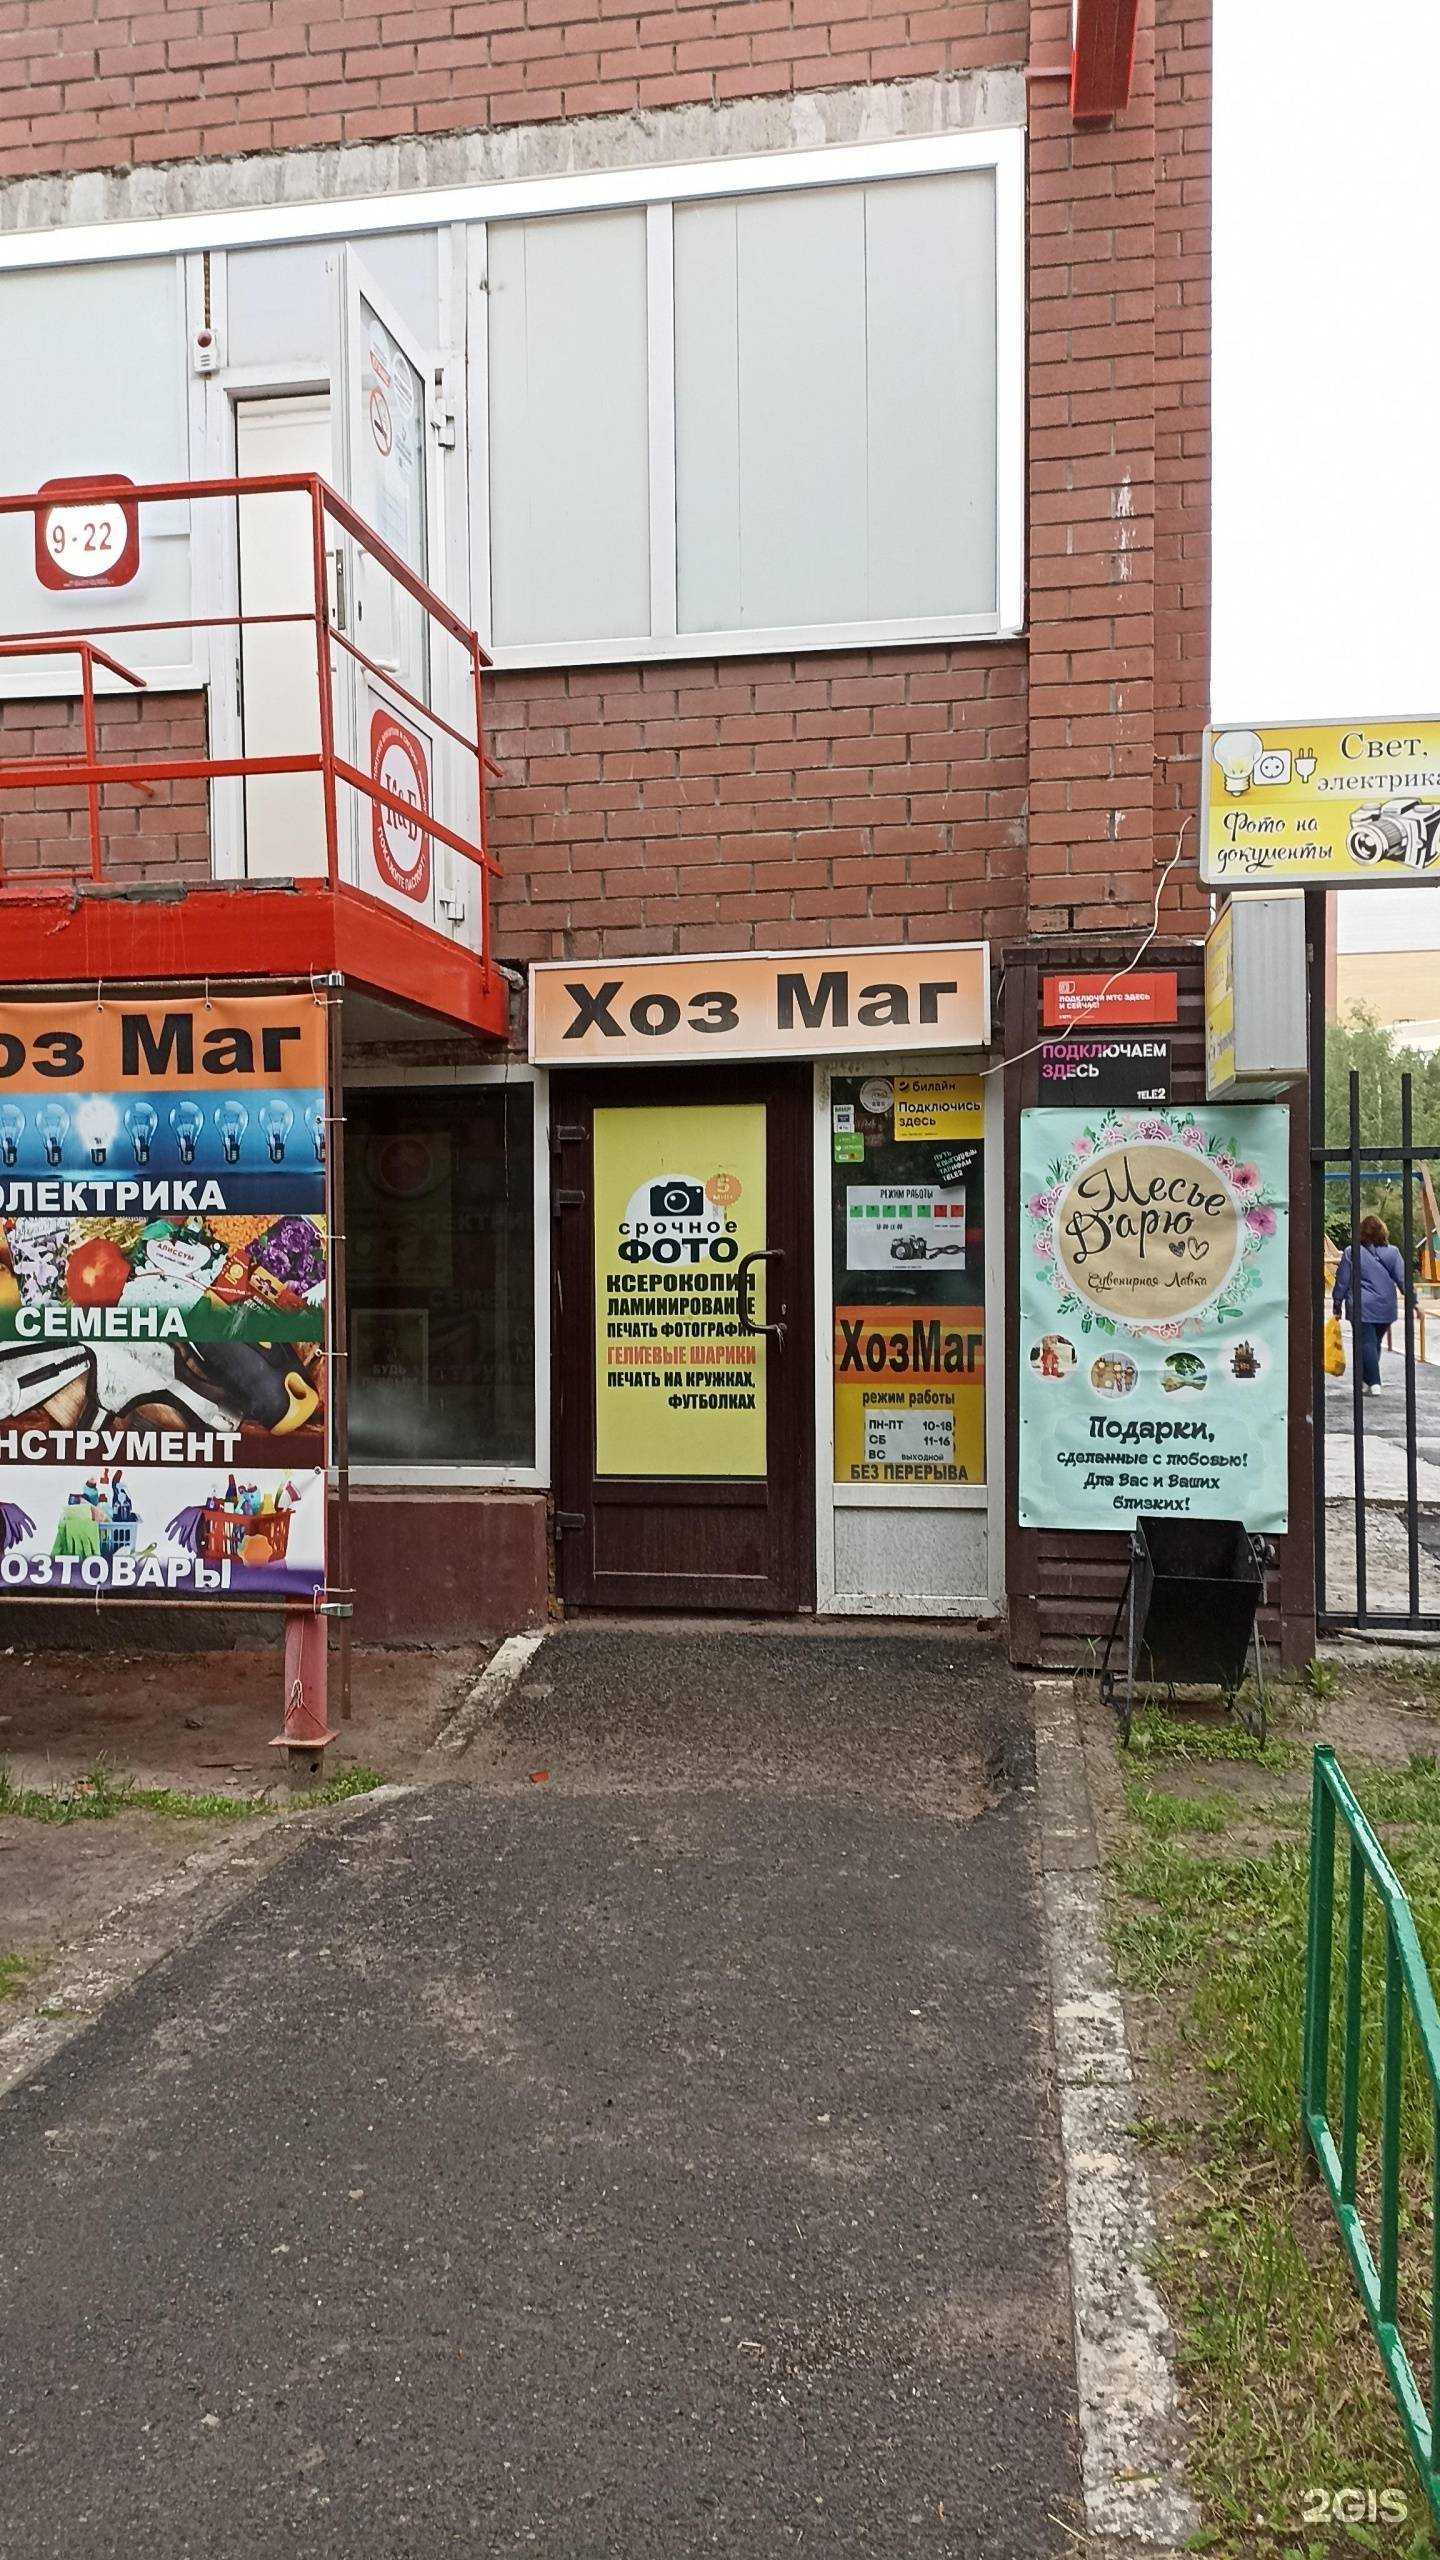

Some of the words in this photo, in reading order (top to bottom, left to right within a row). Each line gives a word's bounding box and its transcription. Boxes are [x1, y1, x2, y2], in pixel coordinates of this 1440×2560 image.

[1341, 732, 1428, 759] Свет,
[1223, 811, 1286, 842] Фото
[1296, 818, 1318, 832] на
[1217, 843, 1333, 874] документы
[562, 980, 740, 1040] Хоз
[777, 970, 958, 1030] Маг
[121, 1013, 302, 1077] Маг
[1042, 1043, 1167, 1061] ПОДКЛЮЧАЕМ
[1042, 1063, 1100, 1080] ЗДЕСЬ
[912, 1081, 956, 1093] билайн
[1137, 1088, 1166, 1100] TELE2
[899, 1101, 981, 1114] Подключись
[899, 1115, 936, 1128] здесь
[0, 1181, 227, 1212] ЛЕКТРИКА
[618, 1221, 738, 1238] срочное
[617, 1237, 739, 1264] ФОТО
[1088, 1271, 1159, 1293] Сувенирная
[1165, 1271, 1207, 1288] Лавка
[607, 1297, 756, 1316] ЛАМИНИРОВАНЕ
[14, 1305, 188, 1339] СЕМЕНА
[607, 1322, 658, 1338] ПЕЧАТЬ
[607, 1346, 687, 1365] ГЕЛИЕВЫЕ
[690, 1345, 756, 1365] ШАРИКИ
[839, 1319, 982, 1374] ХозМаг
[607, 1371, 661, 1388] ПЕЧАТЬ
[664, 1371, 683, 1388] НА
[686, 1371, 756, 1388] КРУЖКАХ,
[668, 1394, 756, 1410] ФУТБОЛКАХ
[862, 1391, 905, 1406] режим
[909, 1389, 955, 1407] работы
[868, 1419, 904, 1430] ПН-ПТ
[922, 1421, 952, 1432] 10-18
[1089, 1415, 1215, 1444] Подарки,
[868, 1434, 887, 1445] СБ
[923, 1436, 951, 1447] 11-16
[868, 1449, 887, 1460] ВС
[1056, 1452, 1148, 1467] сделанные
[1153, 1453, 1162, 1465] с
[1166, 1453, 1248, 1467] любовью!
[850, 1464, 879, 1480] БЕЗ
[884, 1464, 969, 1481] ПЕРЕРЫВА
[1083, 1472, 1115, 1489] Для
[1118, 1473, 1149, 1487] Вас
[1153, 1475, 1164, 1488] и
[1168, 1474, 1221, 1489] Ваших
[1113, 1496, 1191, 1511] близких!
